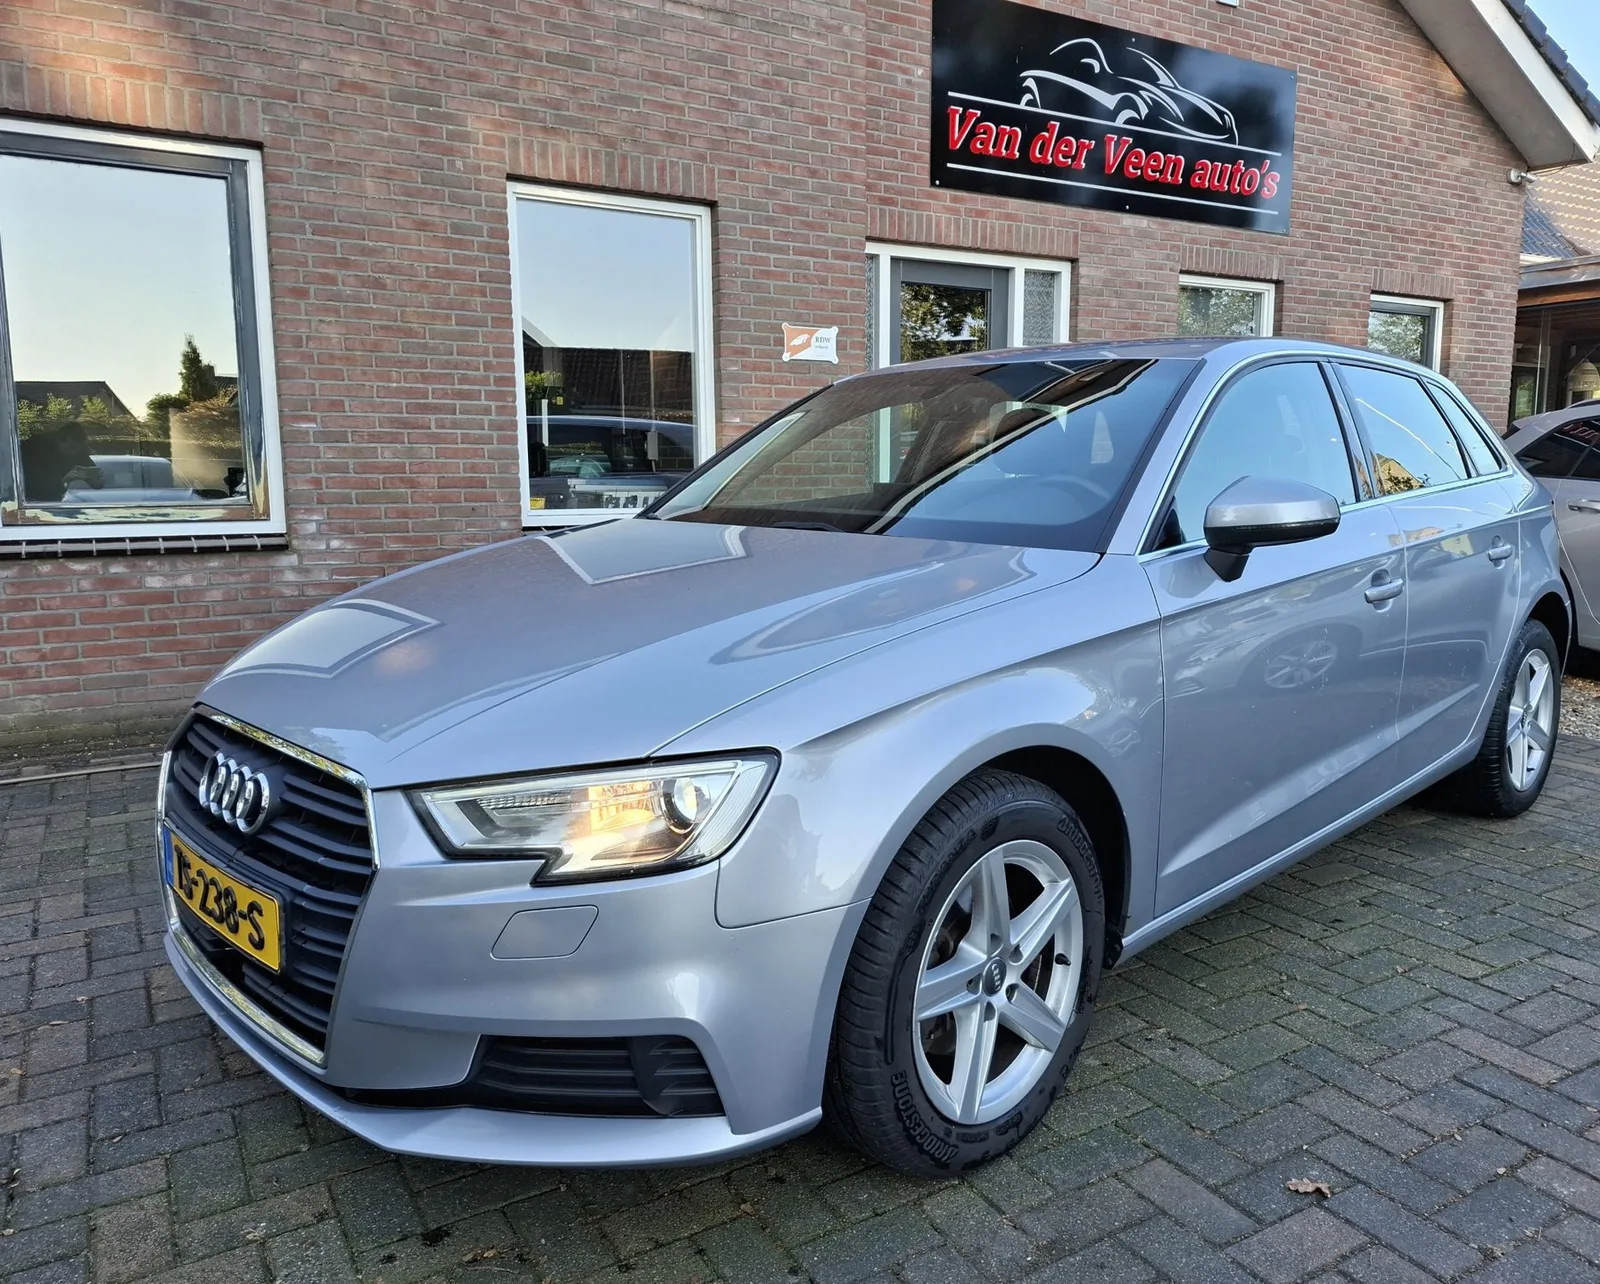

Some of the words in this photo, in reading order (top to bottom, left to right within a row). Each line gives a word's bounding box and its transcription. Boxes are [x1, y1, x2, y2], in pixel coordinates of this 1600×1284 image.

[947, 105, 1022, 161] Van
[1029, 121, 1095, 171] der
[1104, 133, 1186, 185] Veen
[1190, 158, 1281, 200] auto's
[891, 1069, 960, 1166] BRIDGESTONE
